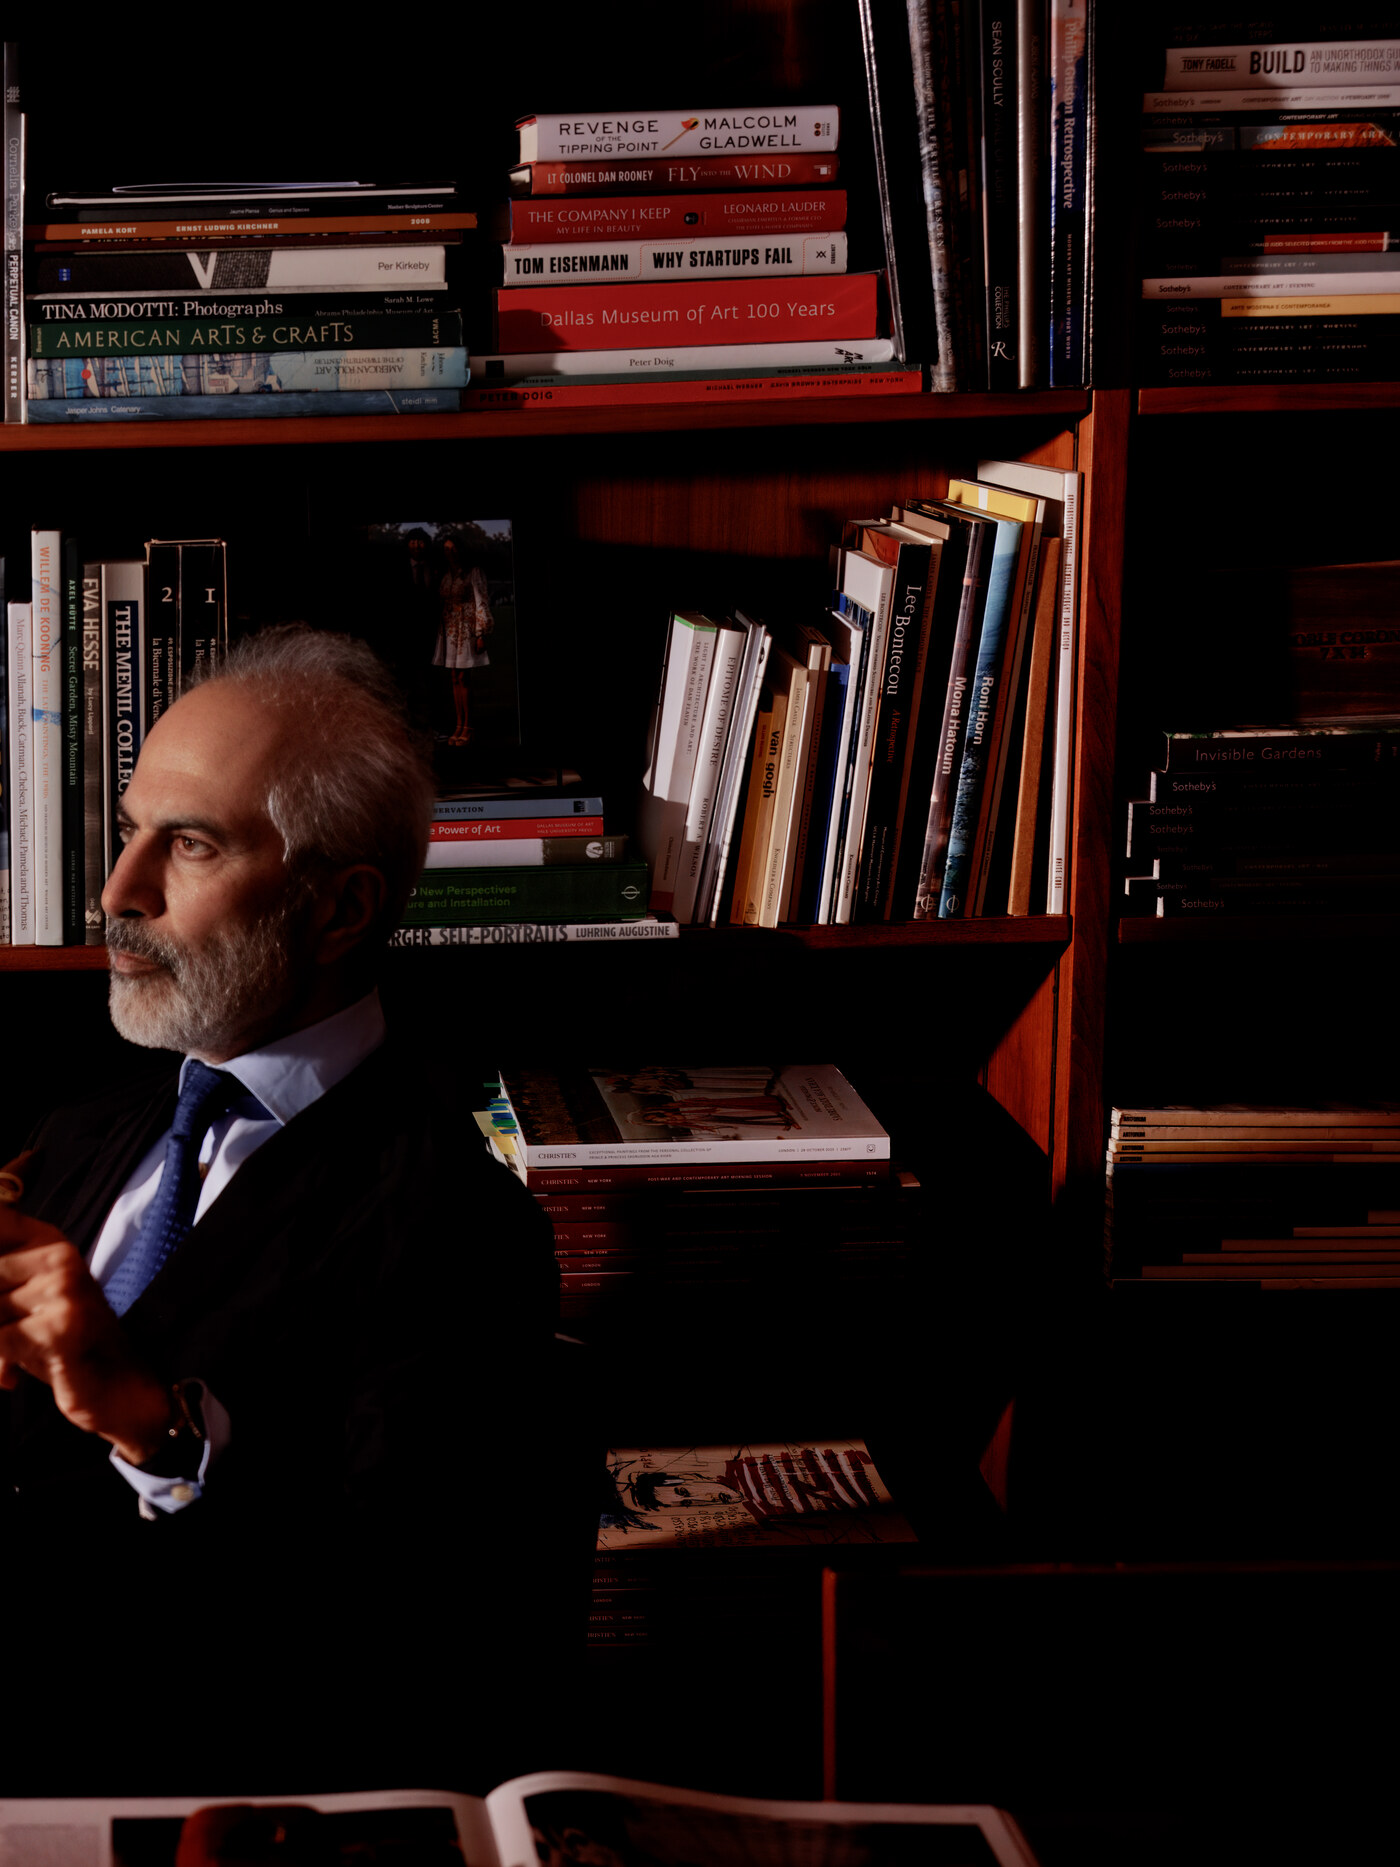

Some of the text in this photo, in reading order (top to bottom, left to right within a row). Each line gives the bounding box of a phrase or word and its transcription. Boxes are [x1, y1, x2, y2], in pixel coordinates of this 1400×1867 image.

[1183, 49, 1306, 75] TONY FADELL BUILD
[704, 115, 797, 130] MALCOLM
[1060, 21, 1078, 209] Philip Guston Retrospective
[559, 119, 659, 136] REVENGE
[558, 141, 659, 154] TIPPING POINT
[699, 134, 802, 150] GLADWELL
[547, 173, 556, 184] LT
[559, 171, 597, 184] COLONEL
[598, 170, 617, 183] DAN
[618, 169, 654, 182] ROONEY
[668, 166, 701, 183] FLY
[733, 163, 792, 180] WIND
[527, 207, 671, 224] THE COMPANY I KEEP
[723, 201, 826, 215] LEONARD LAUDER
[176, 224, 202, 233] ERNST
[203, 223, 235, 232] LUDWIG
[237, 222, 279, 231] KIRCHNER
[377, 260, 430, 272] Per Kirkeby
[514, 247, 793, 275] TOM EISENMANN WHY STARTUPS FAIL
[1158, 284, 1192, 294] Sotheby's
[41, 299, 284, 320] TINA MODOTTI: Photographs
[540, 302, 836, 327] Dallas Museum of Art 100 Years
[56, 321, 354, 349] AMERICAN ARTS & CRAFTS
[629, 357, 675, 368] Peter Doig
[81, 578, 100, 671] EVA HESSE
[115, 605, 132, 649] THE
[880, 584, 923, 695] Lee Bontecou
[115, 650, 133, 718] MENIL
[972, 676, 995, 745] Roni Horn
[941, 676, 968, 775] Mona Hatoum
[762, 730, 781, 799] van gogh
[1195, 746, 1322, 762] Invisible Gardens
[1172, 780, 1217, 794] Sotheby's
[438, 823, 502, 836] Power of Art
[439, 924, 670, 946] SELF-PORTRAITS LUHRING AUGUSTINE
